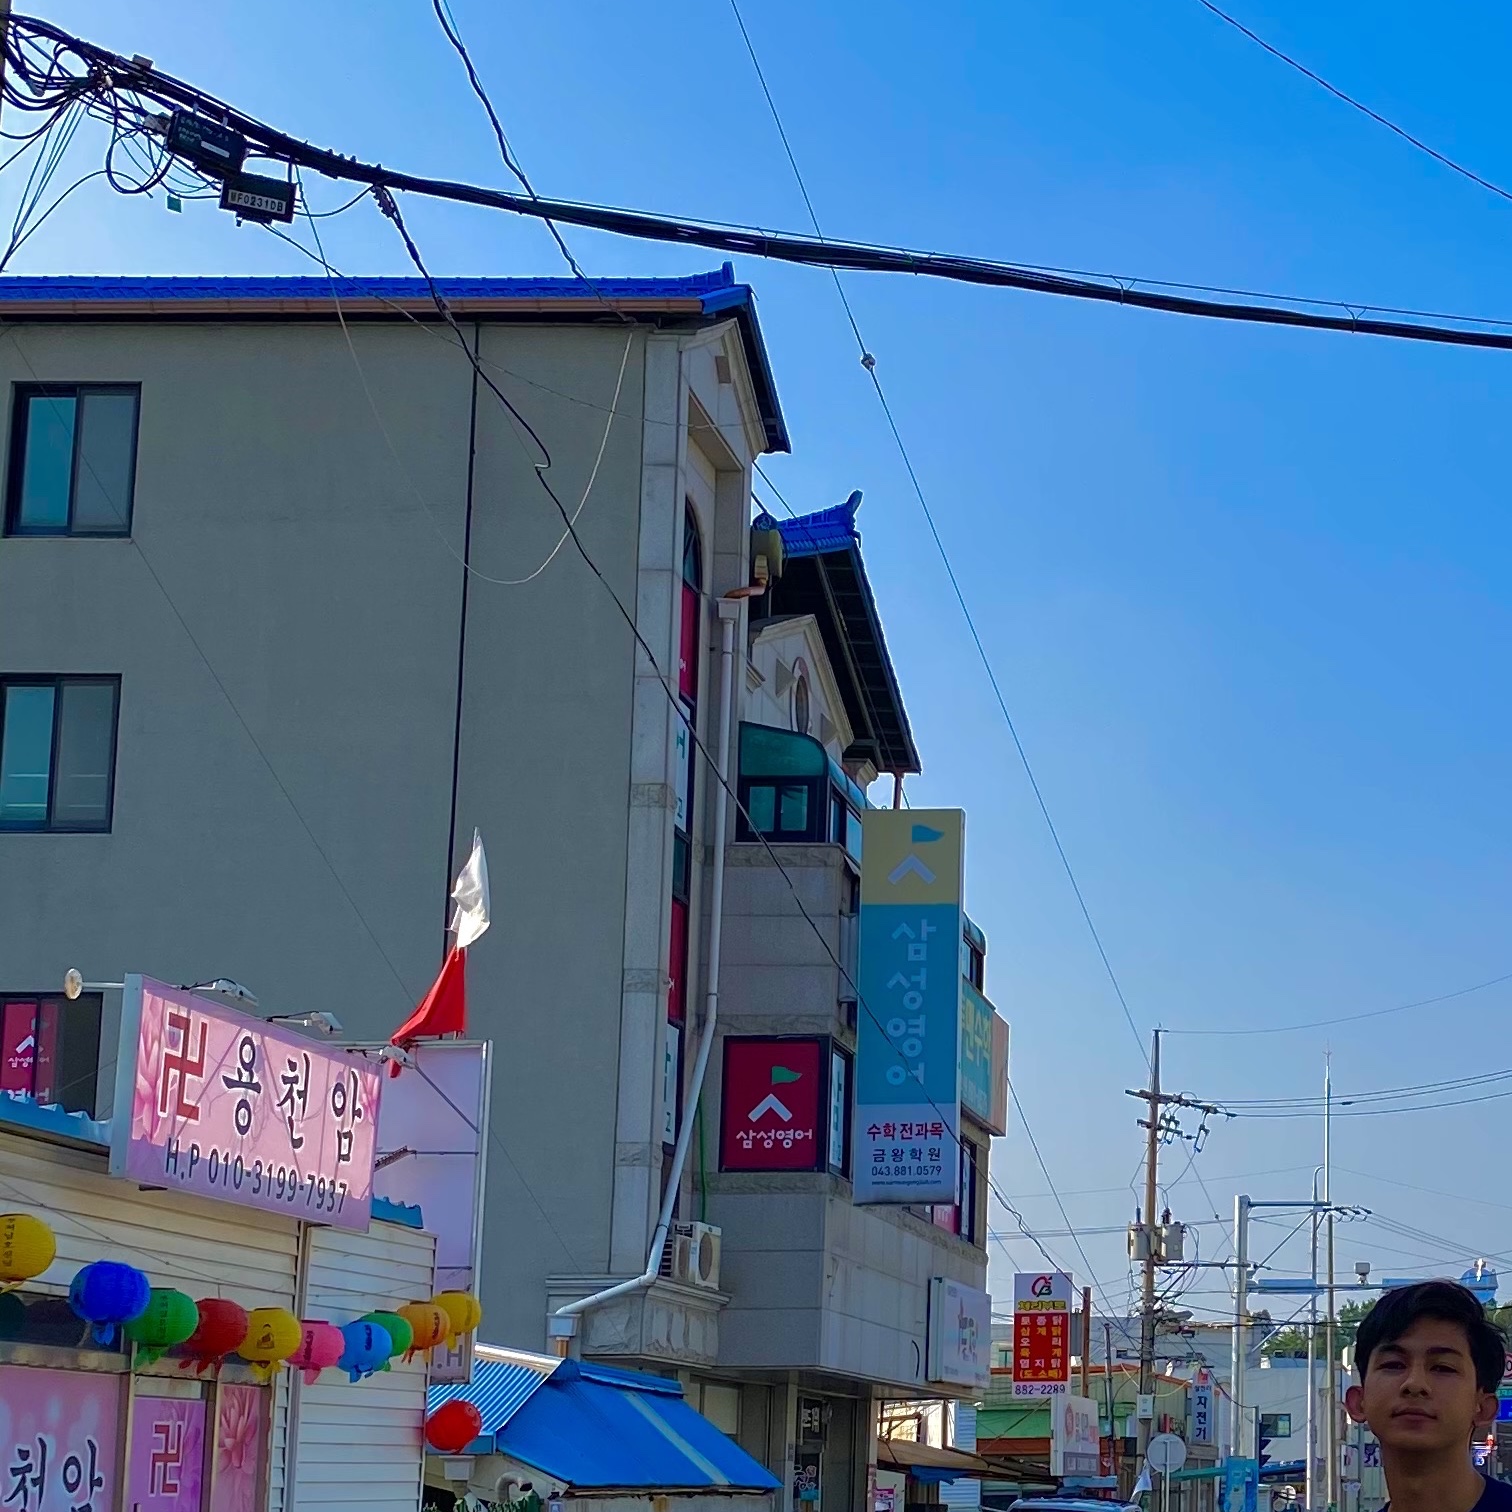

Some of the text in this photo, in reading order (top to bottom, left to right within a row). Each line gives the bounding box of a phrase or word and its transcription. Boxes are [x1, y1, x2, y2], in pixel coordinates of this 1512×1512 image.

[886, 919, 937, 1086] 삼성영어
[222, 1036, 363, 1162] 용천암
[736, 1128, 813, 1149] 삼성영어
[867, 1122, 944, 1141] 수학 전과목
[872, 1147, 942, 1163] 금왕학원
[165, 1138, 348, 1214] H.P 010-3199-7937
[871, 1165, 942, 1177] 043.881.0579
[1014, 1384, 1066, 1395] 882-2289
[1195, 1395, 1208, 1441] 자전거
